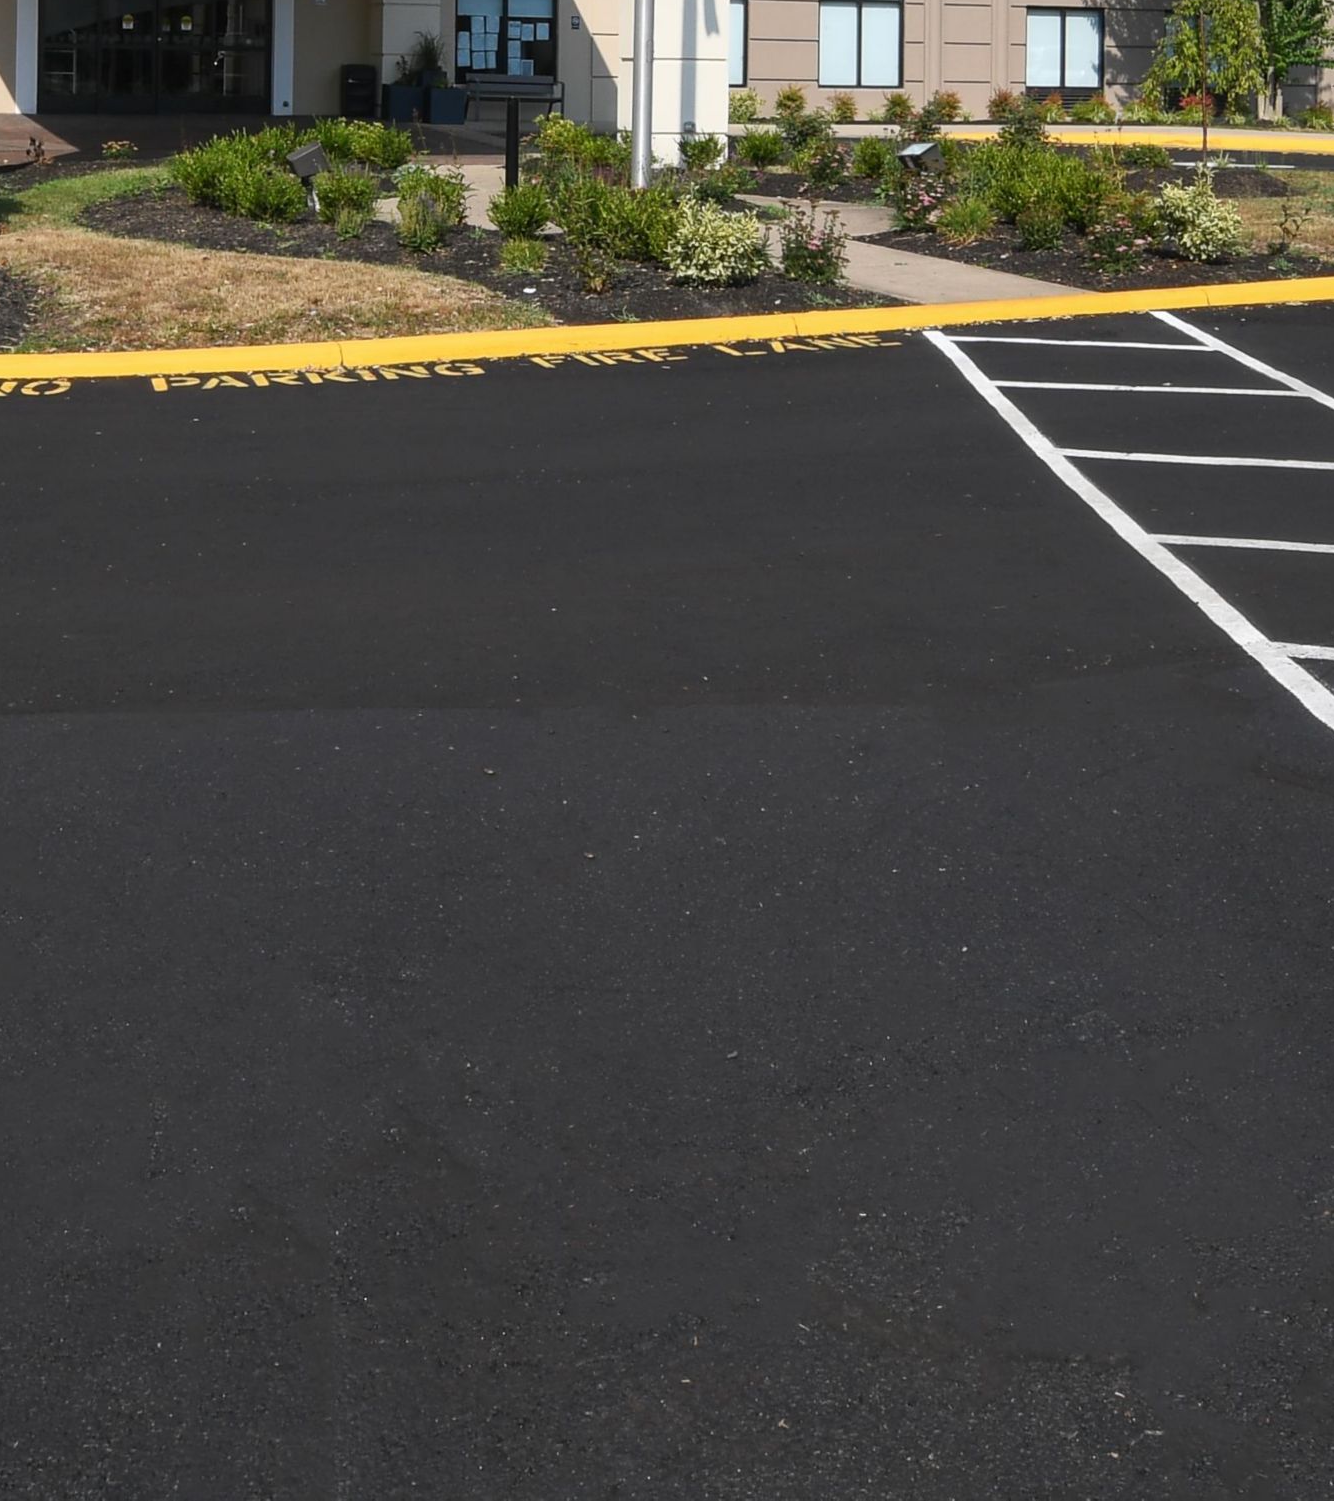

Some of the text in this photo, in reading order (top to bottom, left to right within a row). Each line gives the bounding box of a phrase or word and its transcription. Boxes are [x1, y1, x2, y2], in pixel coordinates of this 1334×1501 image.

[150, 362, 485, 392] PARKING
[529, 346, 688, 368] FIRE
[711, 334, 903, 357] LANE
